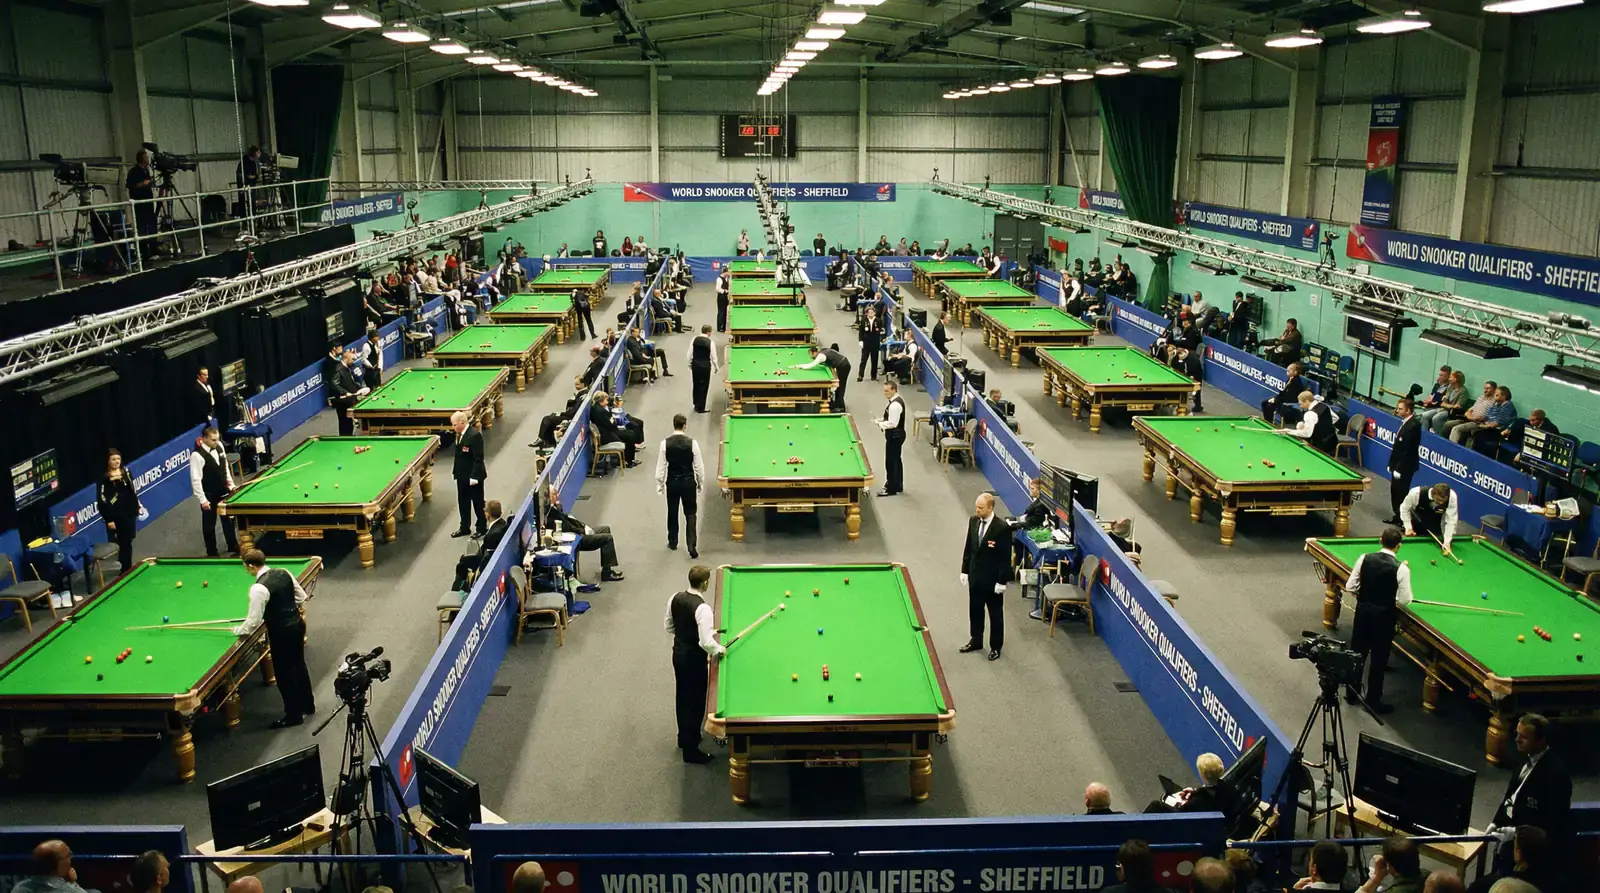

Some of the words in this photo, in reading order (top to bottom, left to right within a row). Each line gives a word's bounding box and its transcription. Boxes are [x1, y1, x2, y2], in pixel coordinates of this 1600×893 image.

[672, 188, 702, 197] WORLD
[705, 188, 745, 197] SNOOKER
[747, 188, 796, 197] QUFIERS
[804, 188, 849, 197] SHEFFIELD
[1388, 240, 1419, 261] WORLD
[1420, 245, 1465, 269] SNOOKER
[1468, 253, 1534, 281] QUALIFIERS
[1430, 450, 1468, 478] QUALIFIERS
[1473, 471, 1512, 499] SHEFFIELD
[1110, 572, 1130, 609] WORLD
[1130, 597, 1159, 645] SNOOKER
[1158, 632, 1198, 692] QUALIFIERS
[1201, 685, 1244, 752] SHEFFIELD
[433, 671, 458, 722] SNOOKER
[601, 873, 688, 893] WORLD
[696, 871, 808, 893] SNOOKER
[817, 868, 955, 893] QUALIFIERS
[979, 865, 1104, 892] SHEFFIELD
